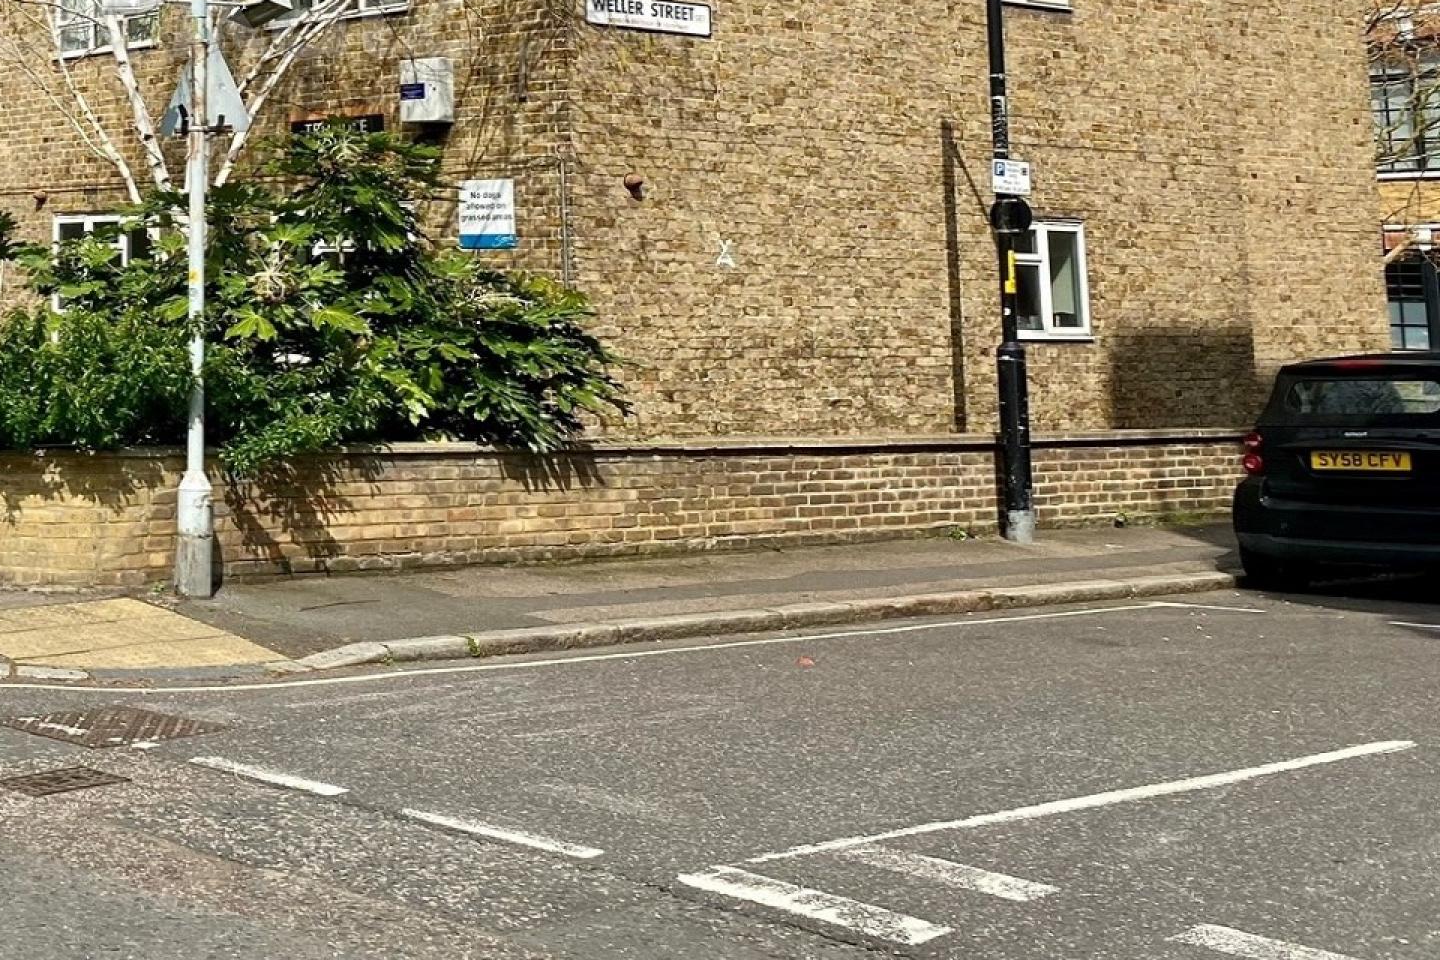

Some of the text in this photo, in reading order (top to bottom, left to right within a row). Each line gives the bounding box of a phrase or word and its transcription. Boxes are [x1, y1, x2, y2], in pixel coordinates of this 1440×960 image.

[650, 3, 694, 21] STREET
[1318, 453, 1402, 467] SY58 CFV
